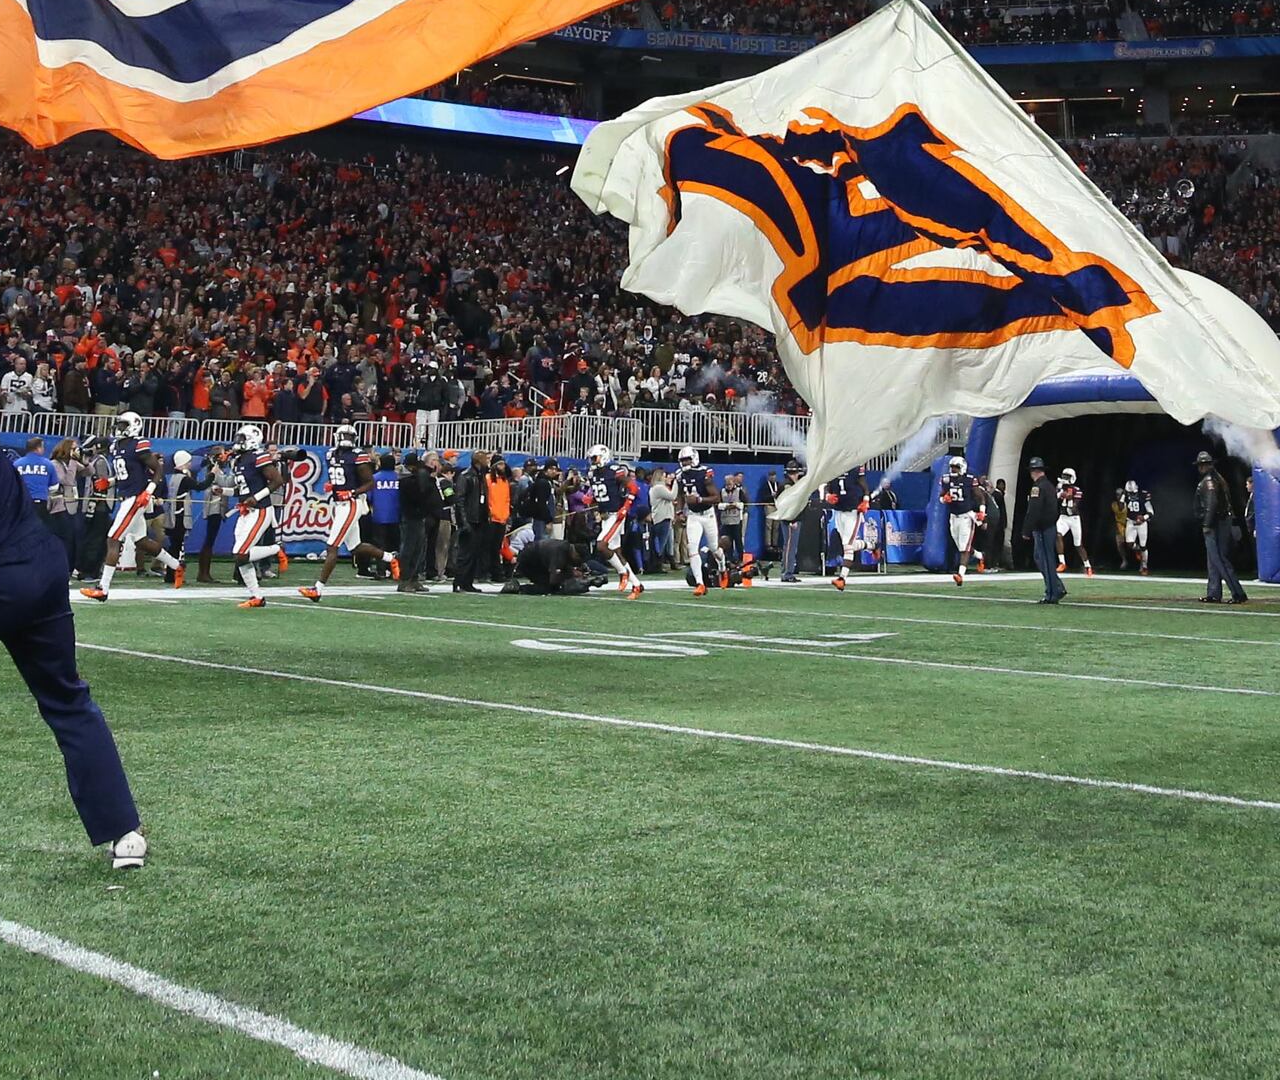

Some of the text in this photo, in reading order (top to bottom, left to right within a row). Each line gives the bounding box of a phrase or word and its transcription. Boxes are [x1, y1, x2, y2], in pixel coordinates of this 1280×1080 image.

[647, 31, 726, 51] SEMIFINAL
[730, 37, 767, 53] HOST
[949, 488, 965, 502] 51
